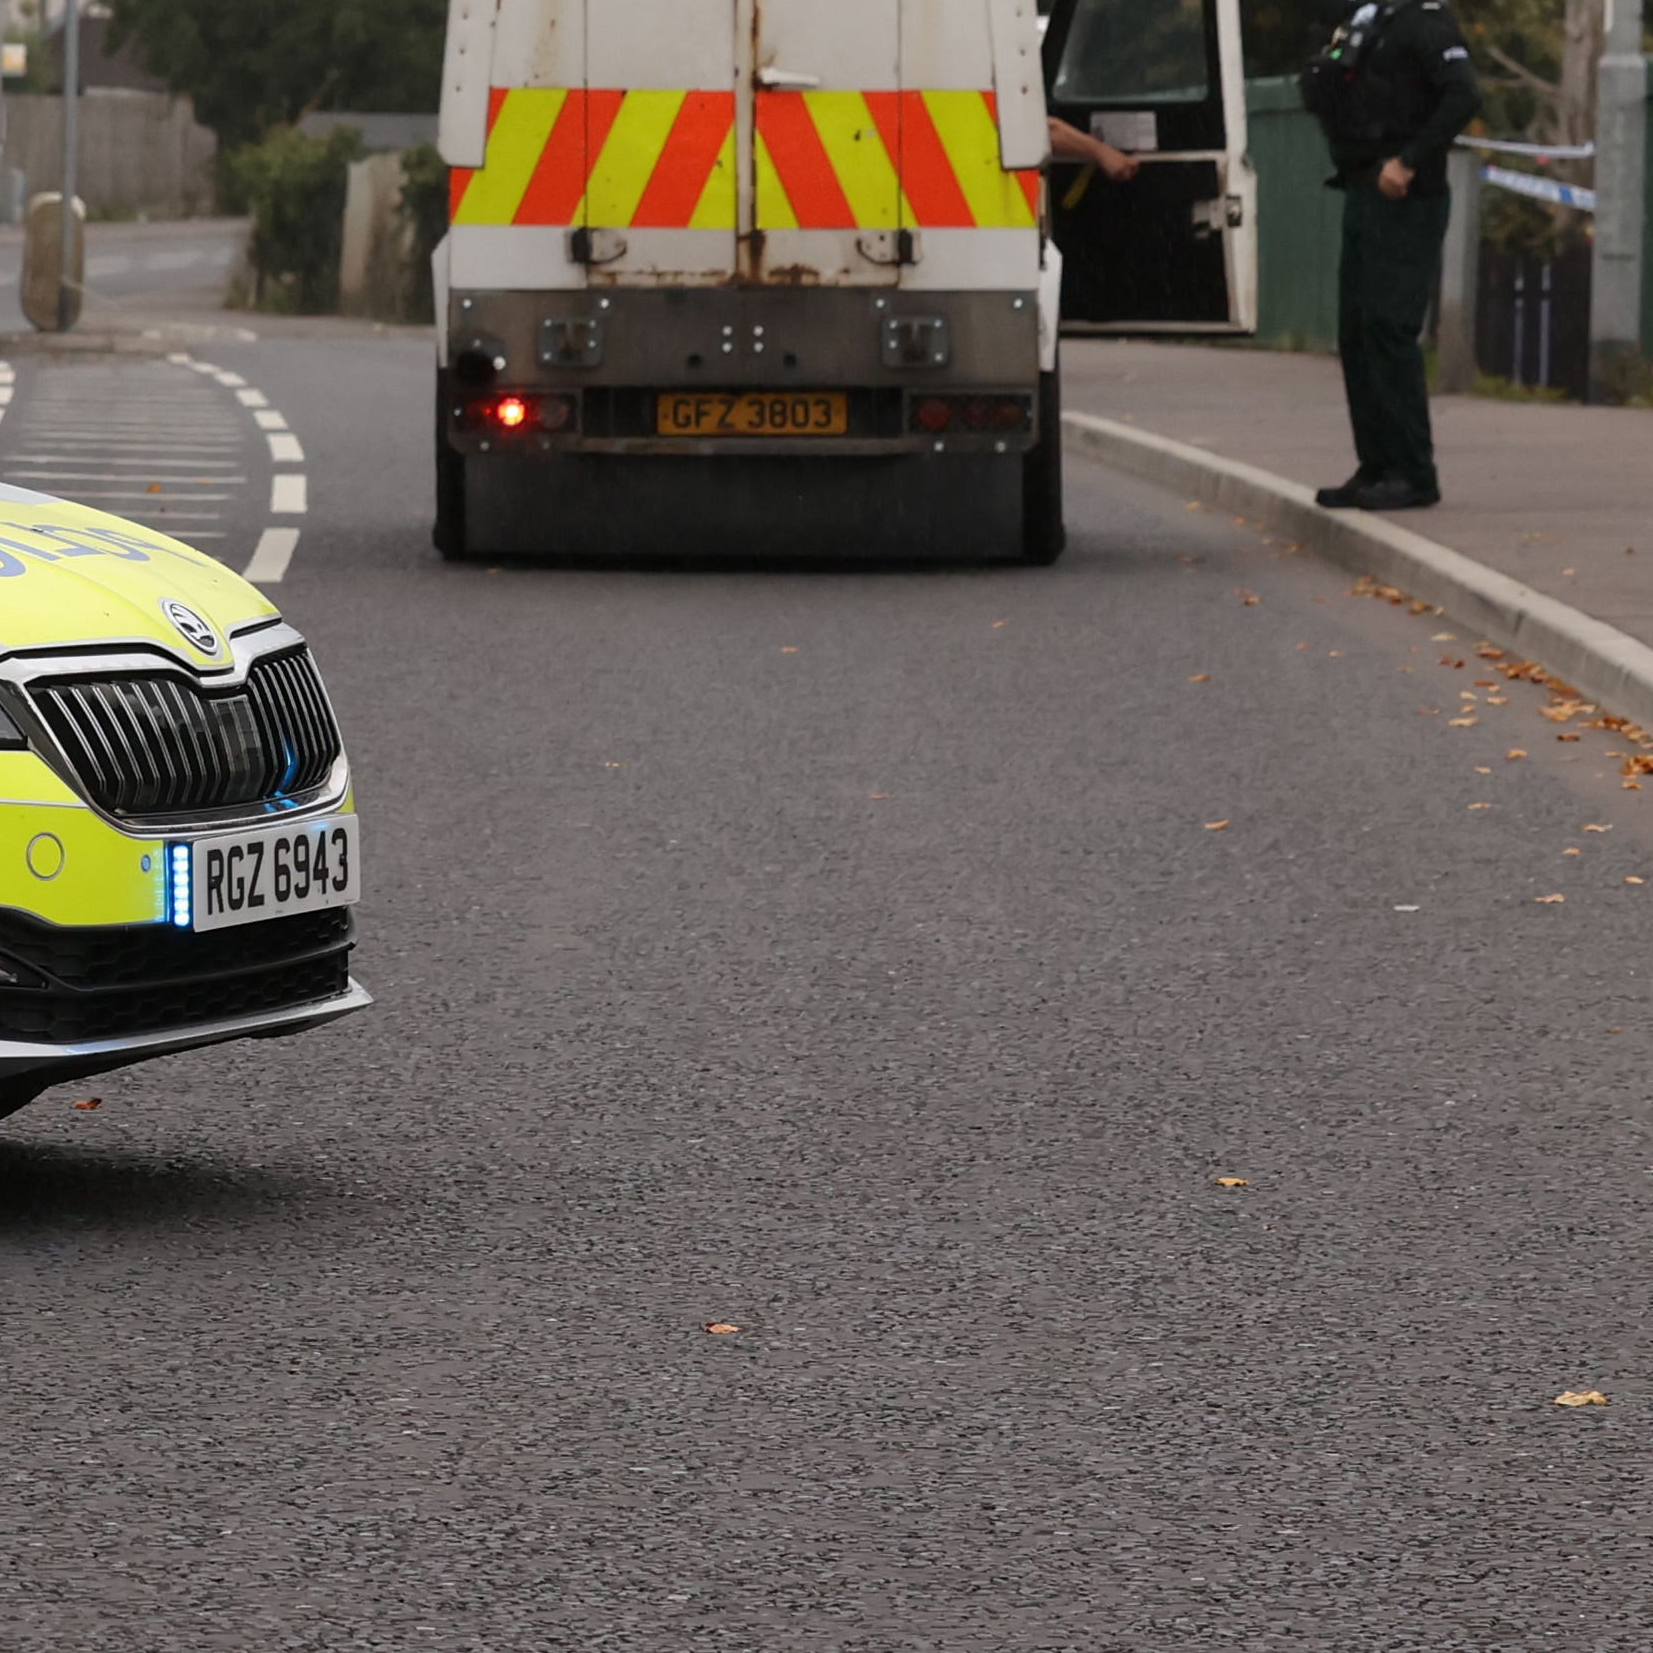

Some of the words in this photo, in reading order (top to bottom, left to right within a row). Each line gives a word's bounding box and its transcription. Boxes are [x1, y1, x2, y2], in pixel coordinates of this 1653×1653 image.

[672, 398, 735, 429] GFZ
[748, 398, 832, 429] 3803
[206, 841, 265, 916] RGZ
[274, 827, 349, 903] 6943
